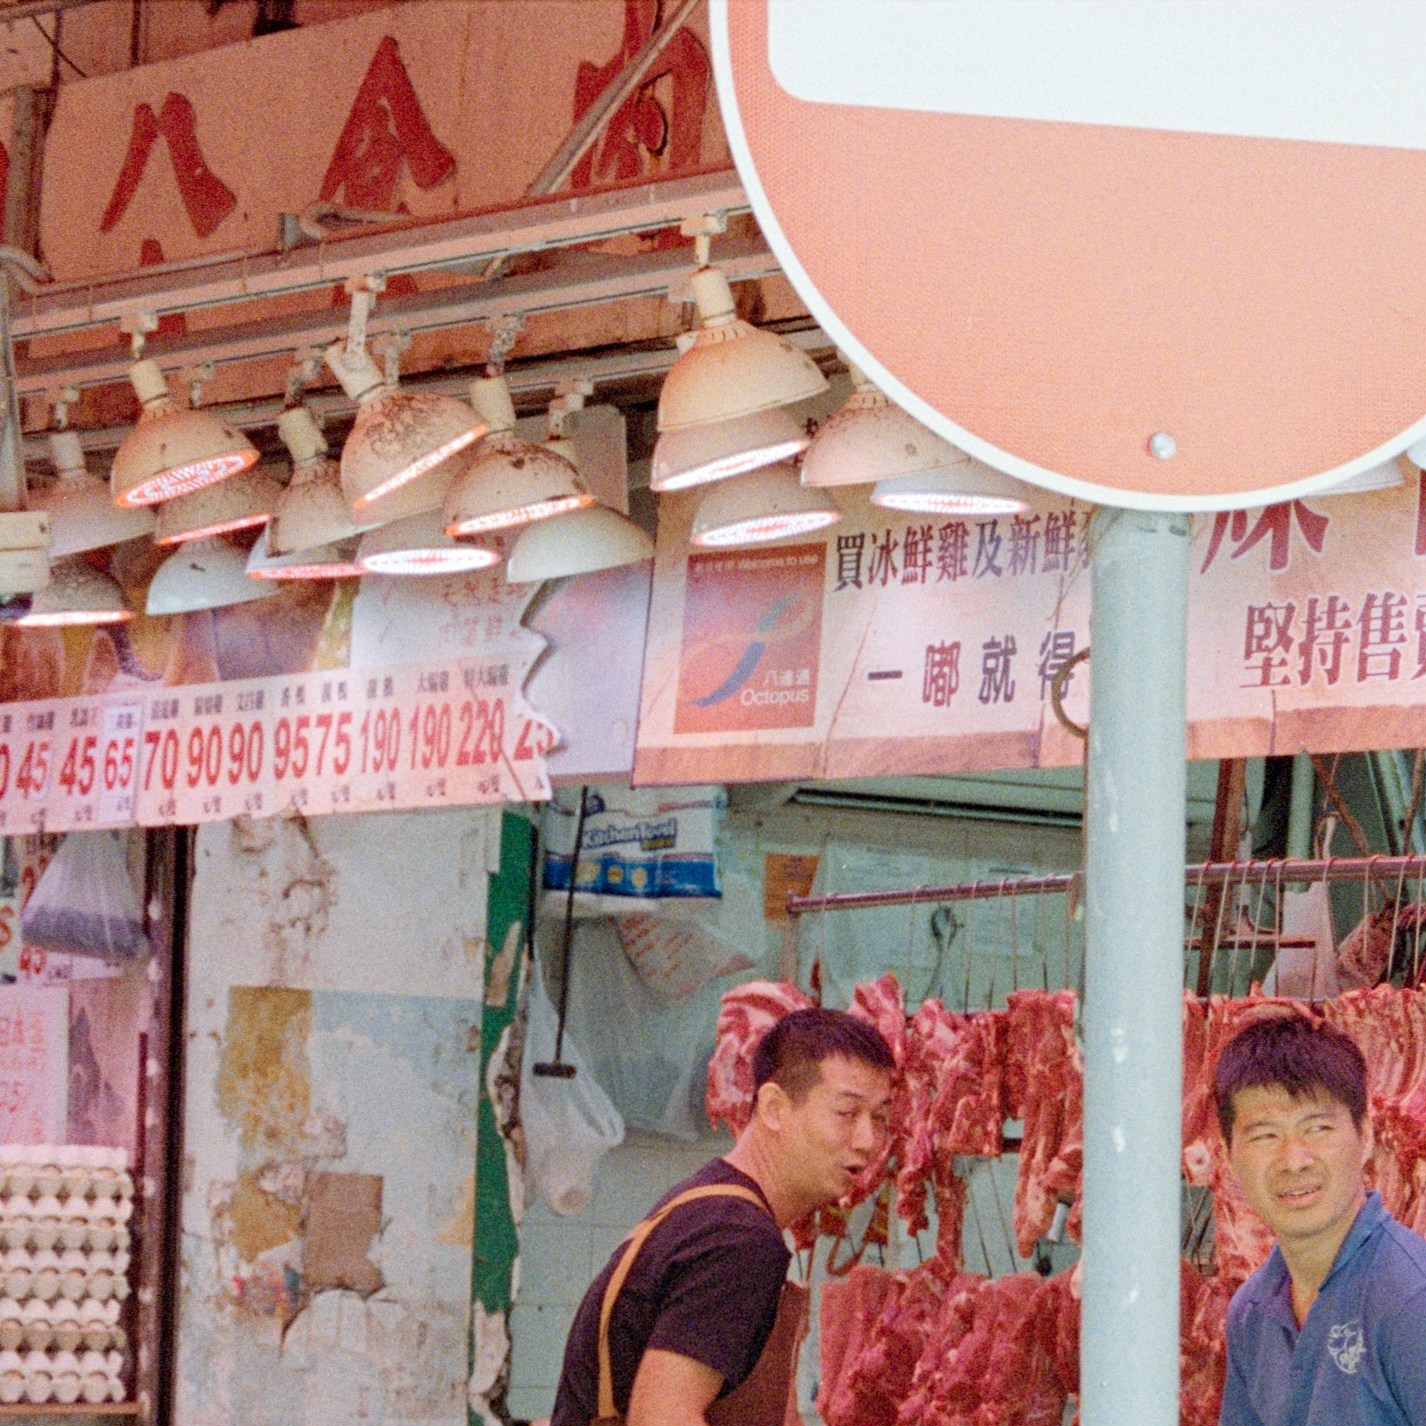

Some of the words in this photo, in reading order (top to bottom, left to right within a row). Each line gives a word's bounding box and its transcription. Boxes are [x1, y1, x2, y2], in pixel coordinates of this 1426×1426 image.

[740, 688, 810, 706] Octopus
[16, 740, 49, 799] 45
[59, 735, 97, 796] 45
[104, 737, 134, 790] 65
[143, 728, 179, 790] 70
[187, 724, 222, 788] 90
[228, 720, 263, 785] 90
[273, 715, 311, 780] 95
[315, 711, 352, 776] 75
[360, 706, 400, 773] 190
[409, 702, 451, 770] 190
[456, 698, 505, 766] 220
